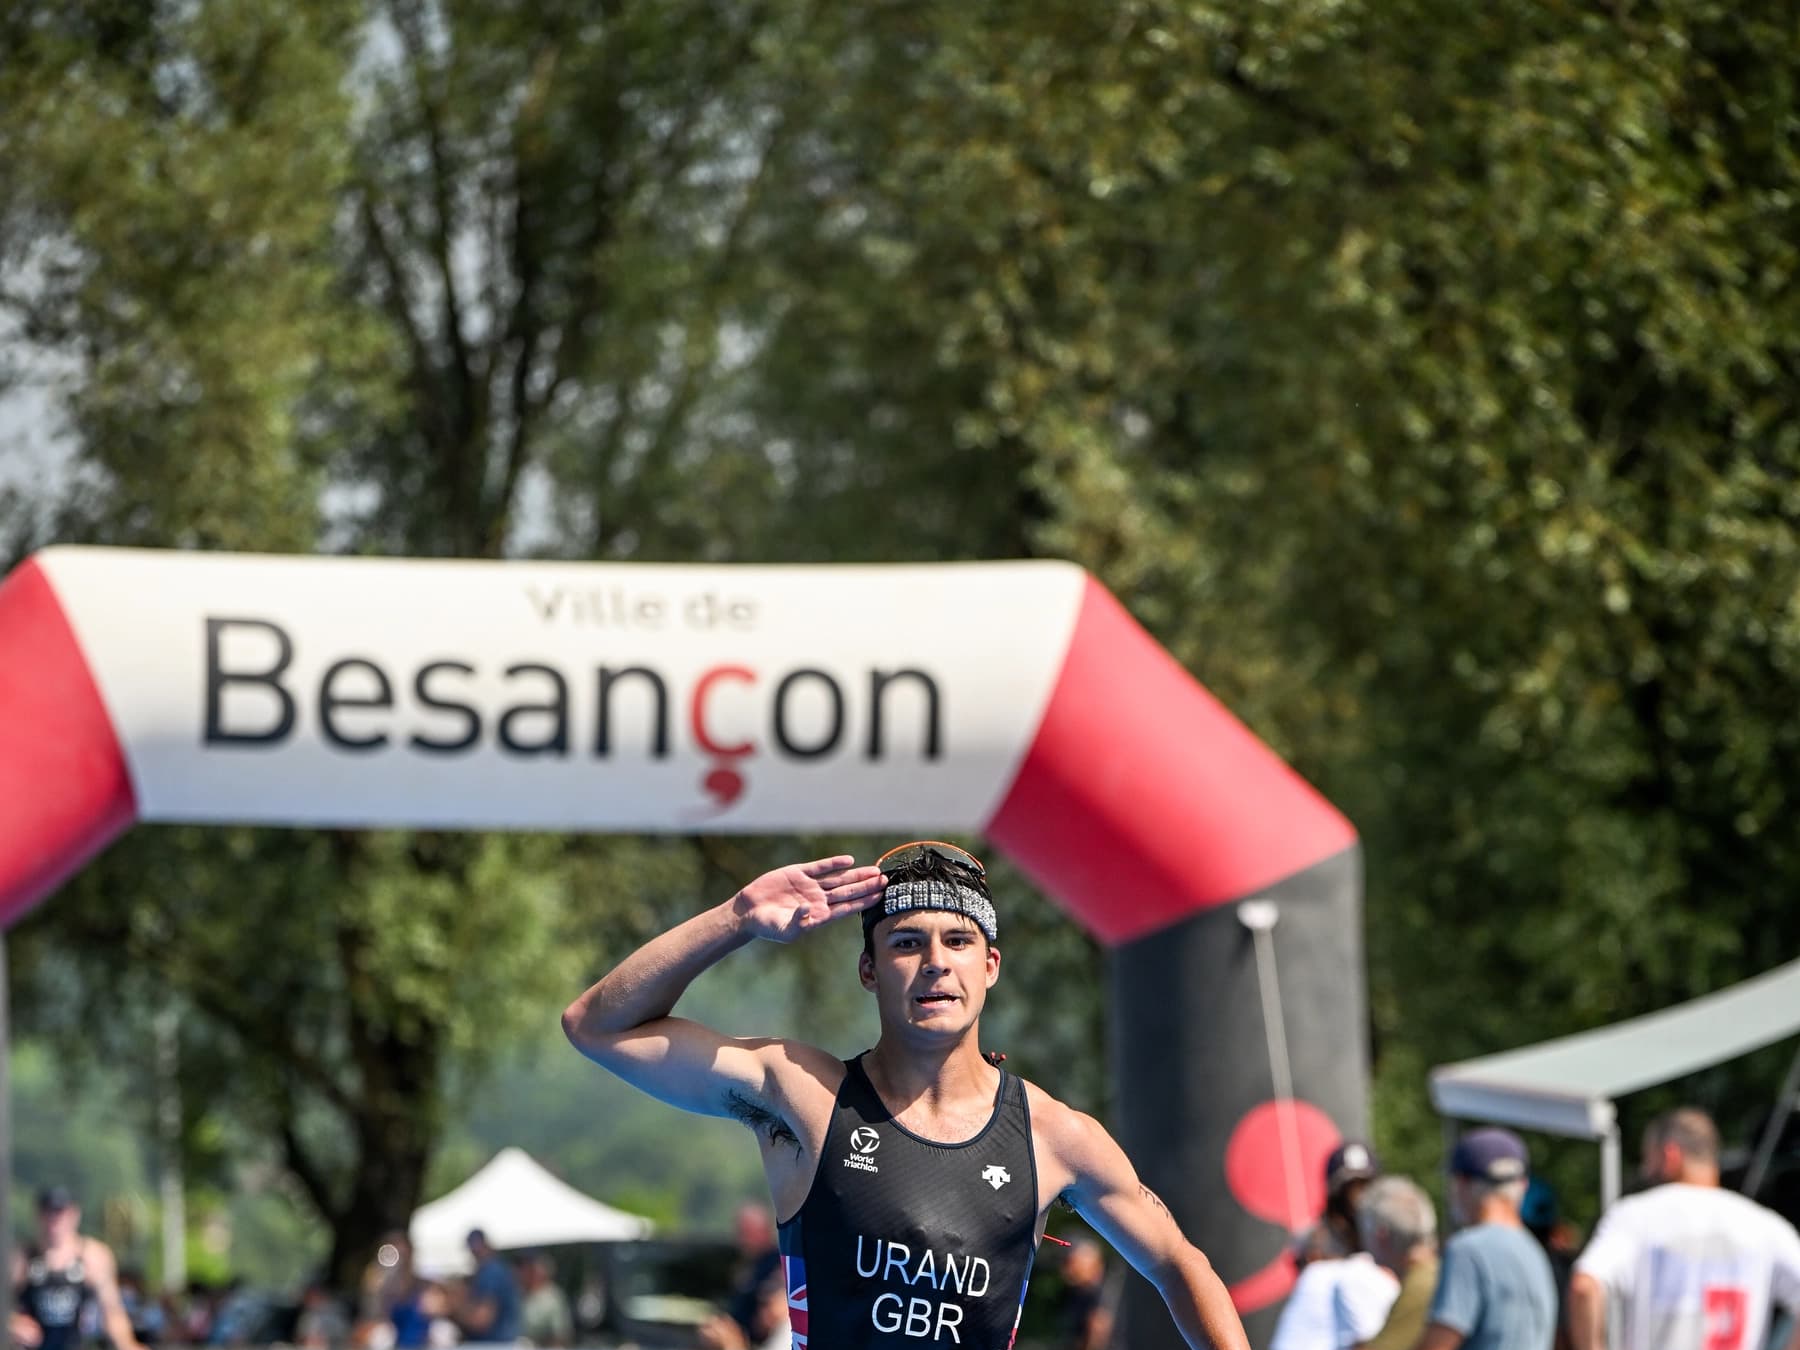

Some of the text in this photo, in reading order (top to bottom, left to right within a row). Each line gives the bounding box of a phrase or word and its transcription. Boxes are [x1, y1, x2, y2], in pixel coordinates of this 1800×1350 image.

[524, 587, 758, 631] Ville de
[203, 616, 945, 808] Besançon
[843, 1159, 879, 1173] Triathlon
[850, 1153, 874, 1164] World
[856, 1235, 990, 1297] URAND
[871, 1292, 963, 1344] GBR
